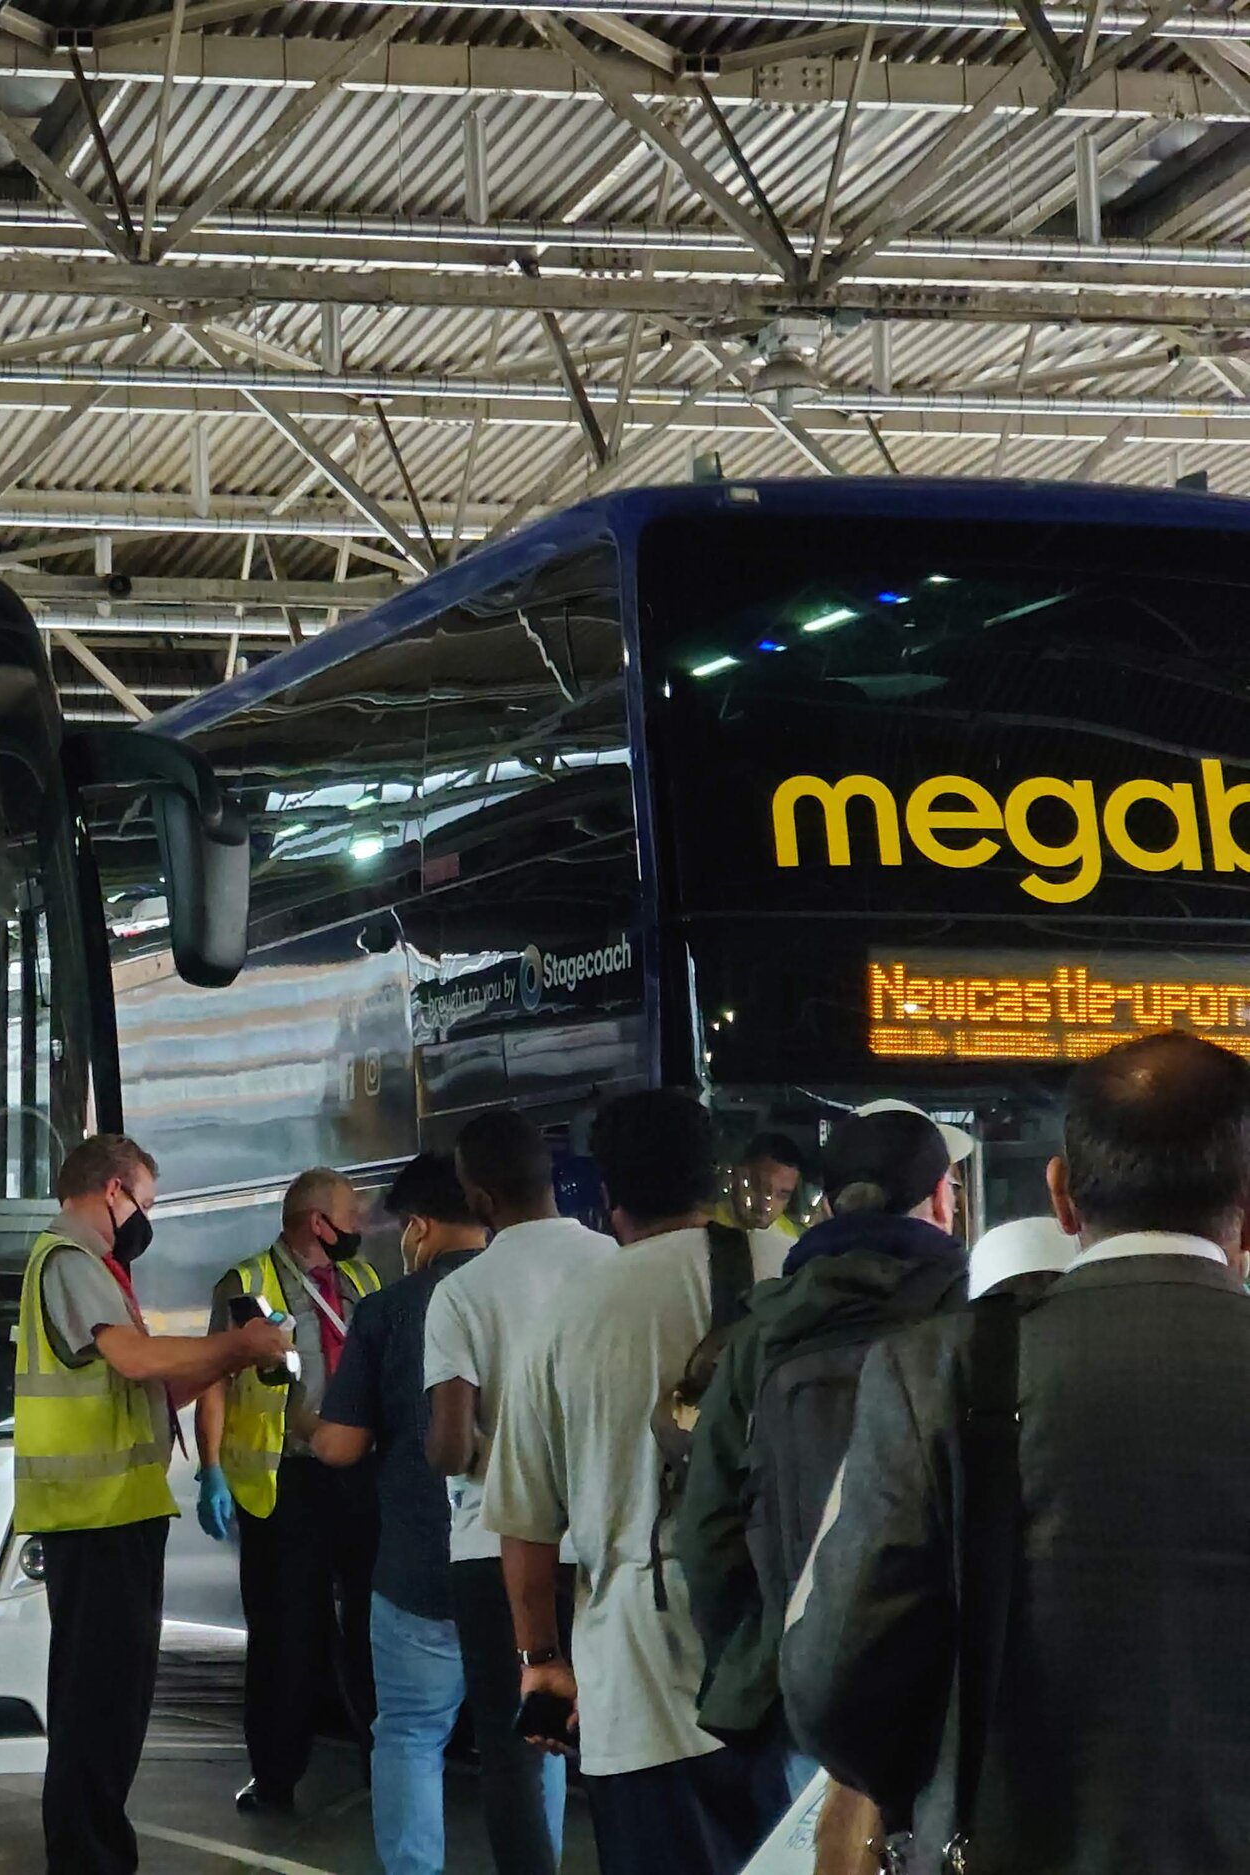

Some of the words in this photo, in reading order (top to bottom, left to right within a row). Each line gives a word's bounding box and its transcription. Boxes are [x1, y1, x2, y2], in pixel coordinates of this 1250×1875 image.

[428, 983, 466, 1016] brought
[468, 984, 480, 1004] to
[481, 980, 501, 1012] you
[503, 971, 516, 1005] by
[543, 932, 632, 992] Stagecoach
